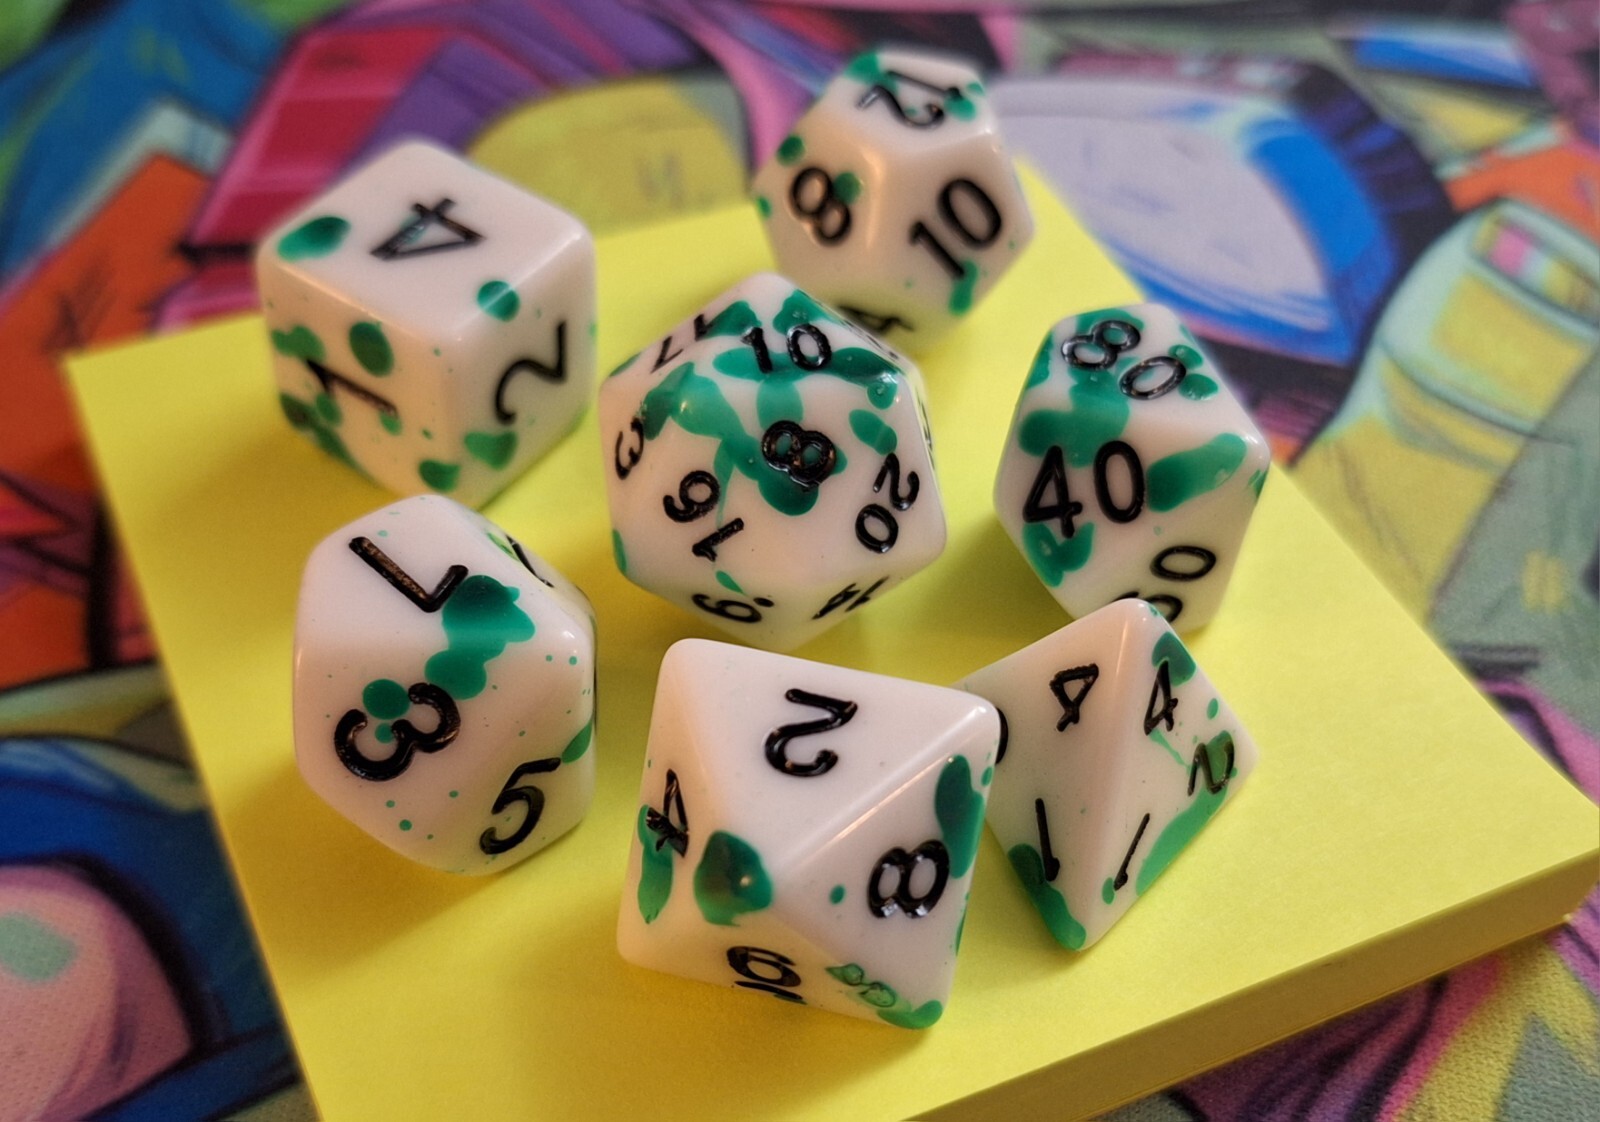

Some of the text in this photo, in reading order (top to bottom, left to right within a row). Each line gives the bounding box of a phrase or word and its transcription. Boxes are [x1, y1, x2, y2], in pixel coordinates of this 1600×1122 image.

[855, 69, 962, 130] 12
[370, 198, 486, 261] 4
[790, 167, 852, 246] 8
[907, 177, 1002, 281] 10
[305, 358, 399, 417] 1
[494, 320, 566, 425] 2
[740, 325, 832, 371] 10
[1061, 319, 1186, 400] 80
[614, 417, 644, 480] 3
[762, 420, 836, 492] 8
[662, 470, 744, 562] 16
[855, 453, 920, 553] 20
[1023, 440, 1145, 538] 40
[349, 536, 468, 613] 7
[334, 682, 461, 782] 3
[764, 688, 858, 777] 2
[1049, 663, 1099, 732] 4
[1144, 660, 1178, 735] 4
[479, 757, 561, 855] 5
[1187, 742, 1236, 796] 2
[646, 768, 690, 859] 4
[1034, 797, 1060, 882] 1
[1113, 812, 1150, 891] 1
[867, 839, 950, 919] 8
